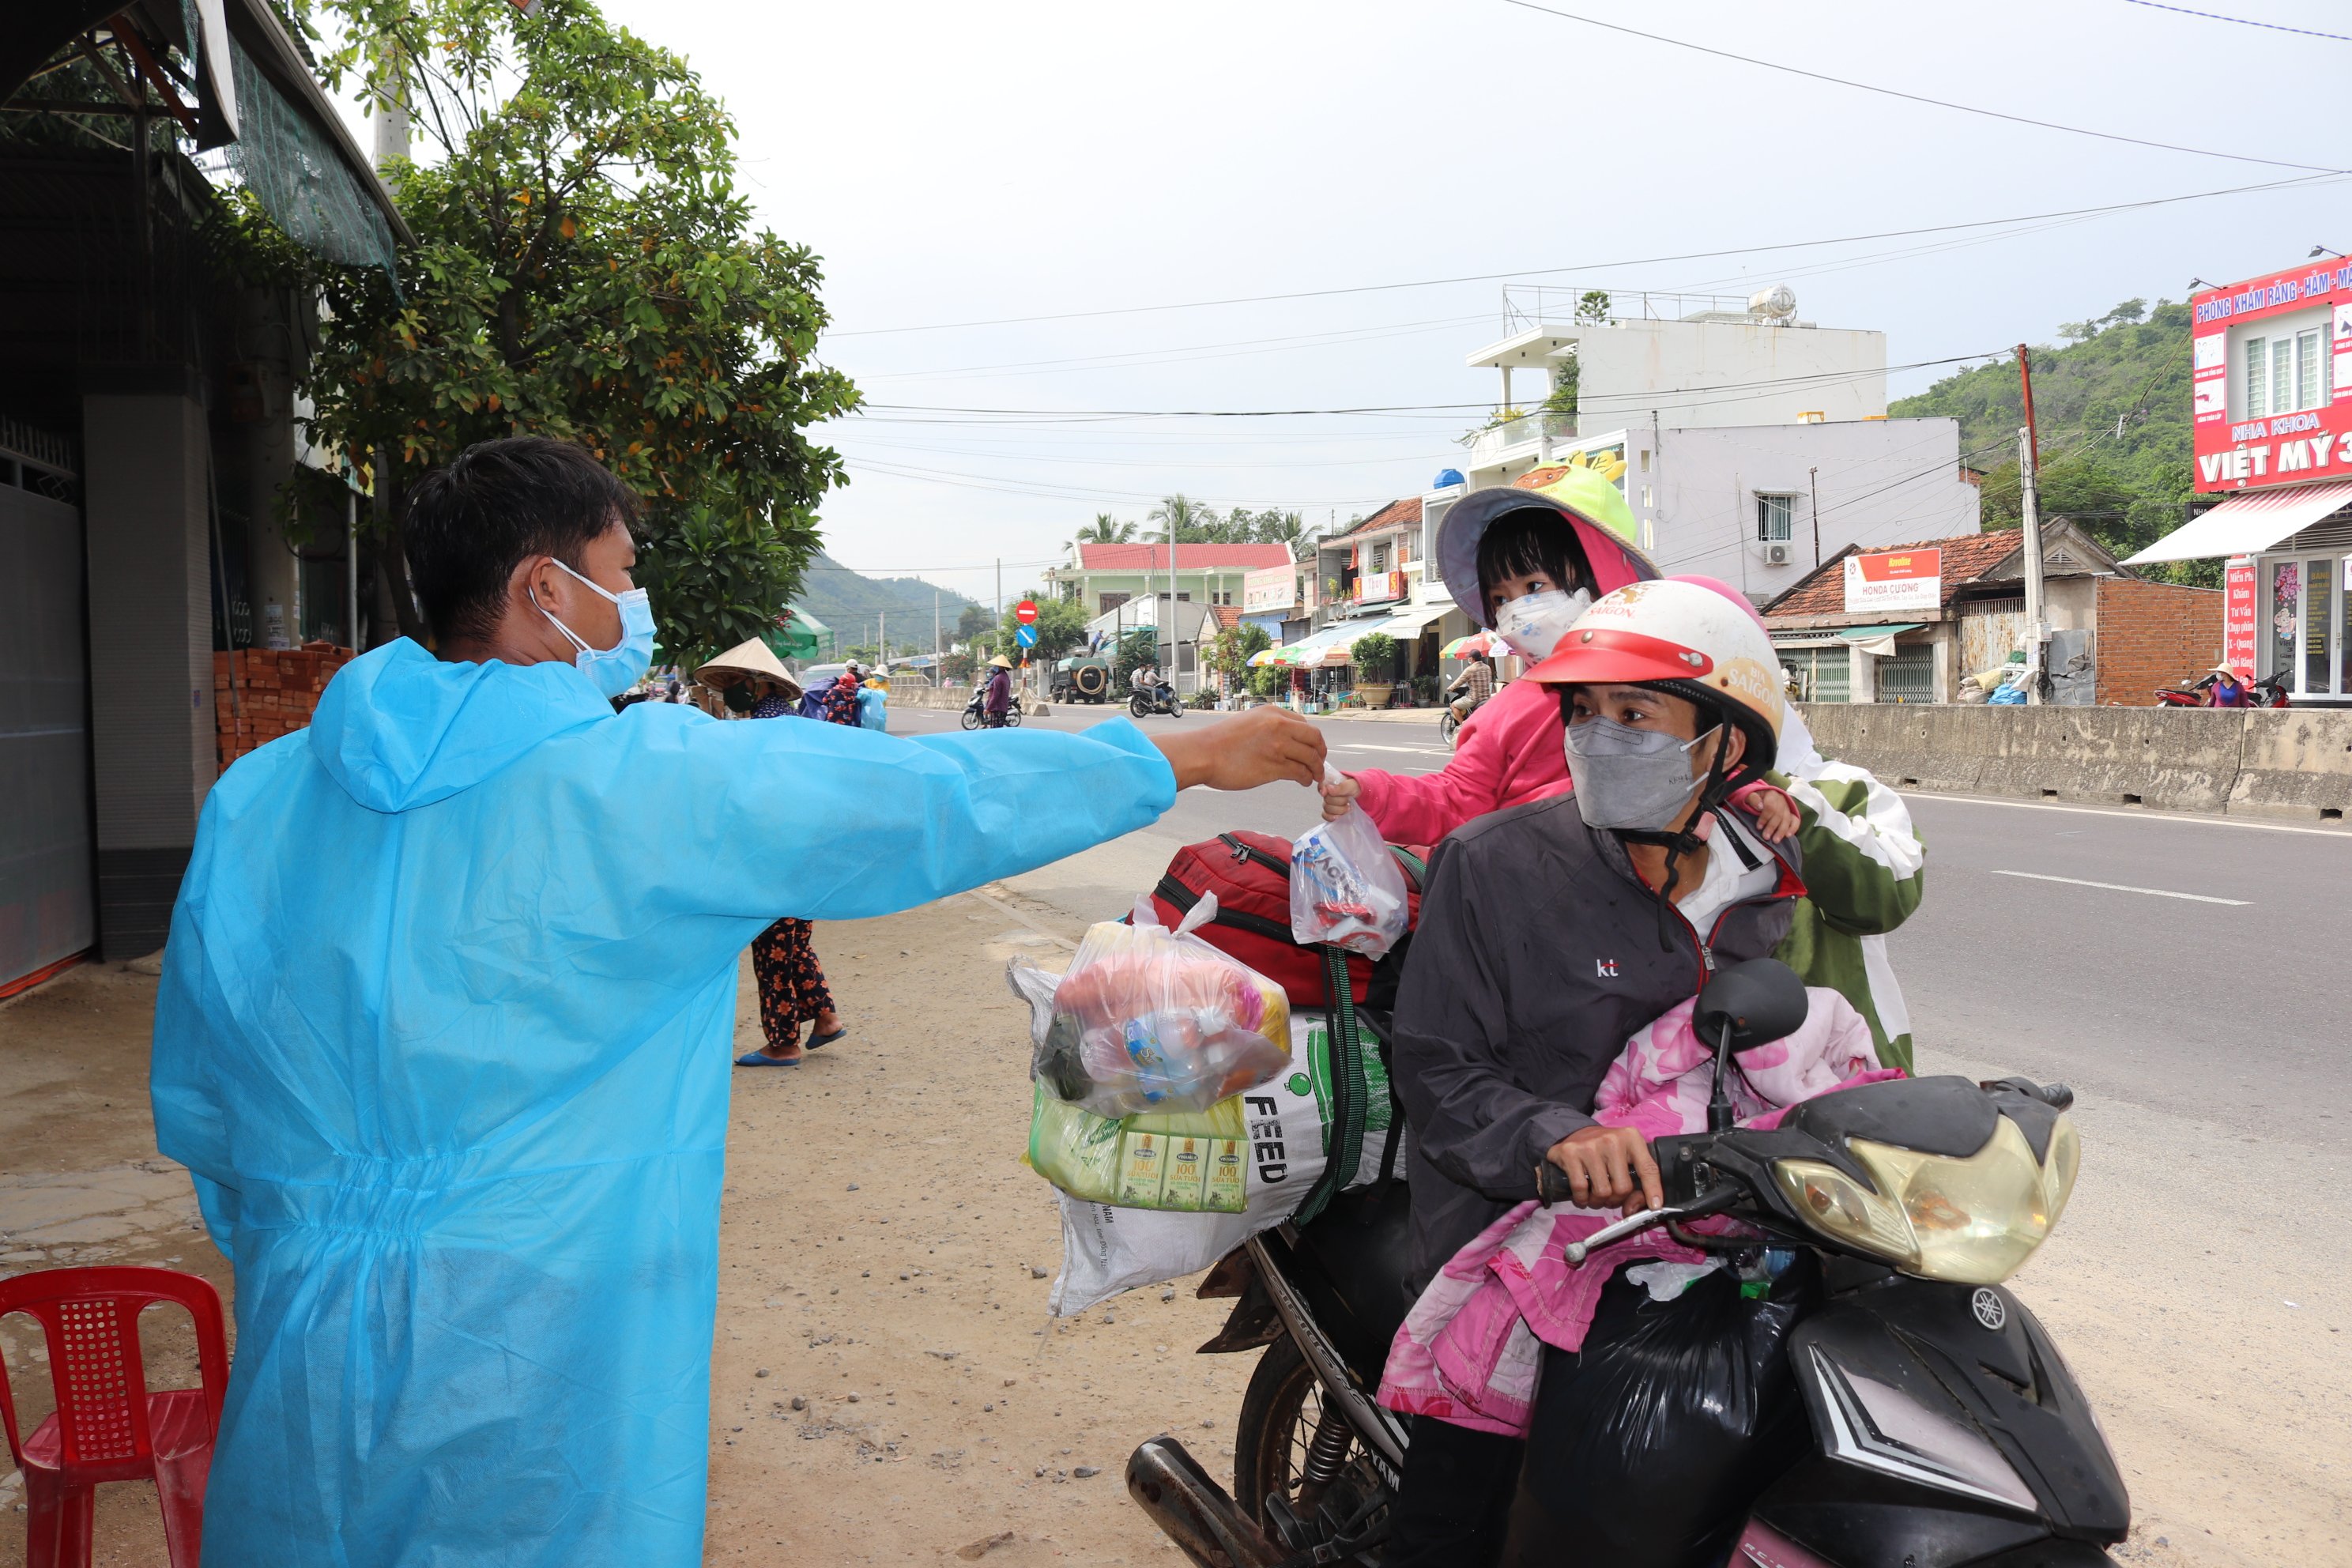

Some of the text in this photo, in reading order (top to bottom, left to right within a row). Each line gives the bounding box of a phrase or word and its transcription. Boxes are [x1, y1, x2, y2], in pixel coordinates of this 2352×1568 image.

[2267, 280, 2297, 306] RĂNG
[2232, 413, 2321, 443] NHA KHOA
[2199, 443, 2271, 488] VIỆT
[2277, 429, 2337, 473] MỸ
[1863, 585, 1888, 595] HONDA
[2233, 587, 2249, 600] Khám
[1588, 606, 1636, 619] SAIGON
[2228, 639, 2233, 649] X
[2237, 638, 2253, 650] Quang
[1751, 666, 1765, 684] BIA
[1728, 668, 1777, 709] SAIGON
[1596, 959, 1619, 978] kt
[1245, 1097, 1288, 1184] FEED
[1102, 1205, 1114, 1223] NAM
[1271, 1275, 1336, 1370] SIRIUS
